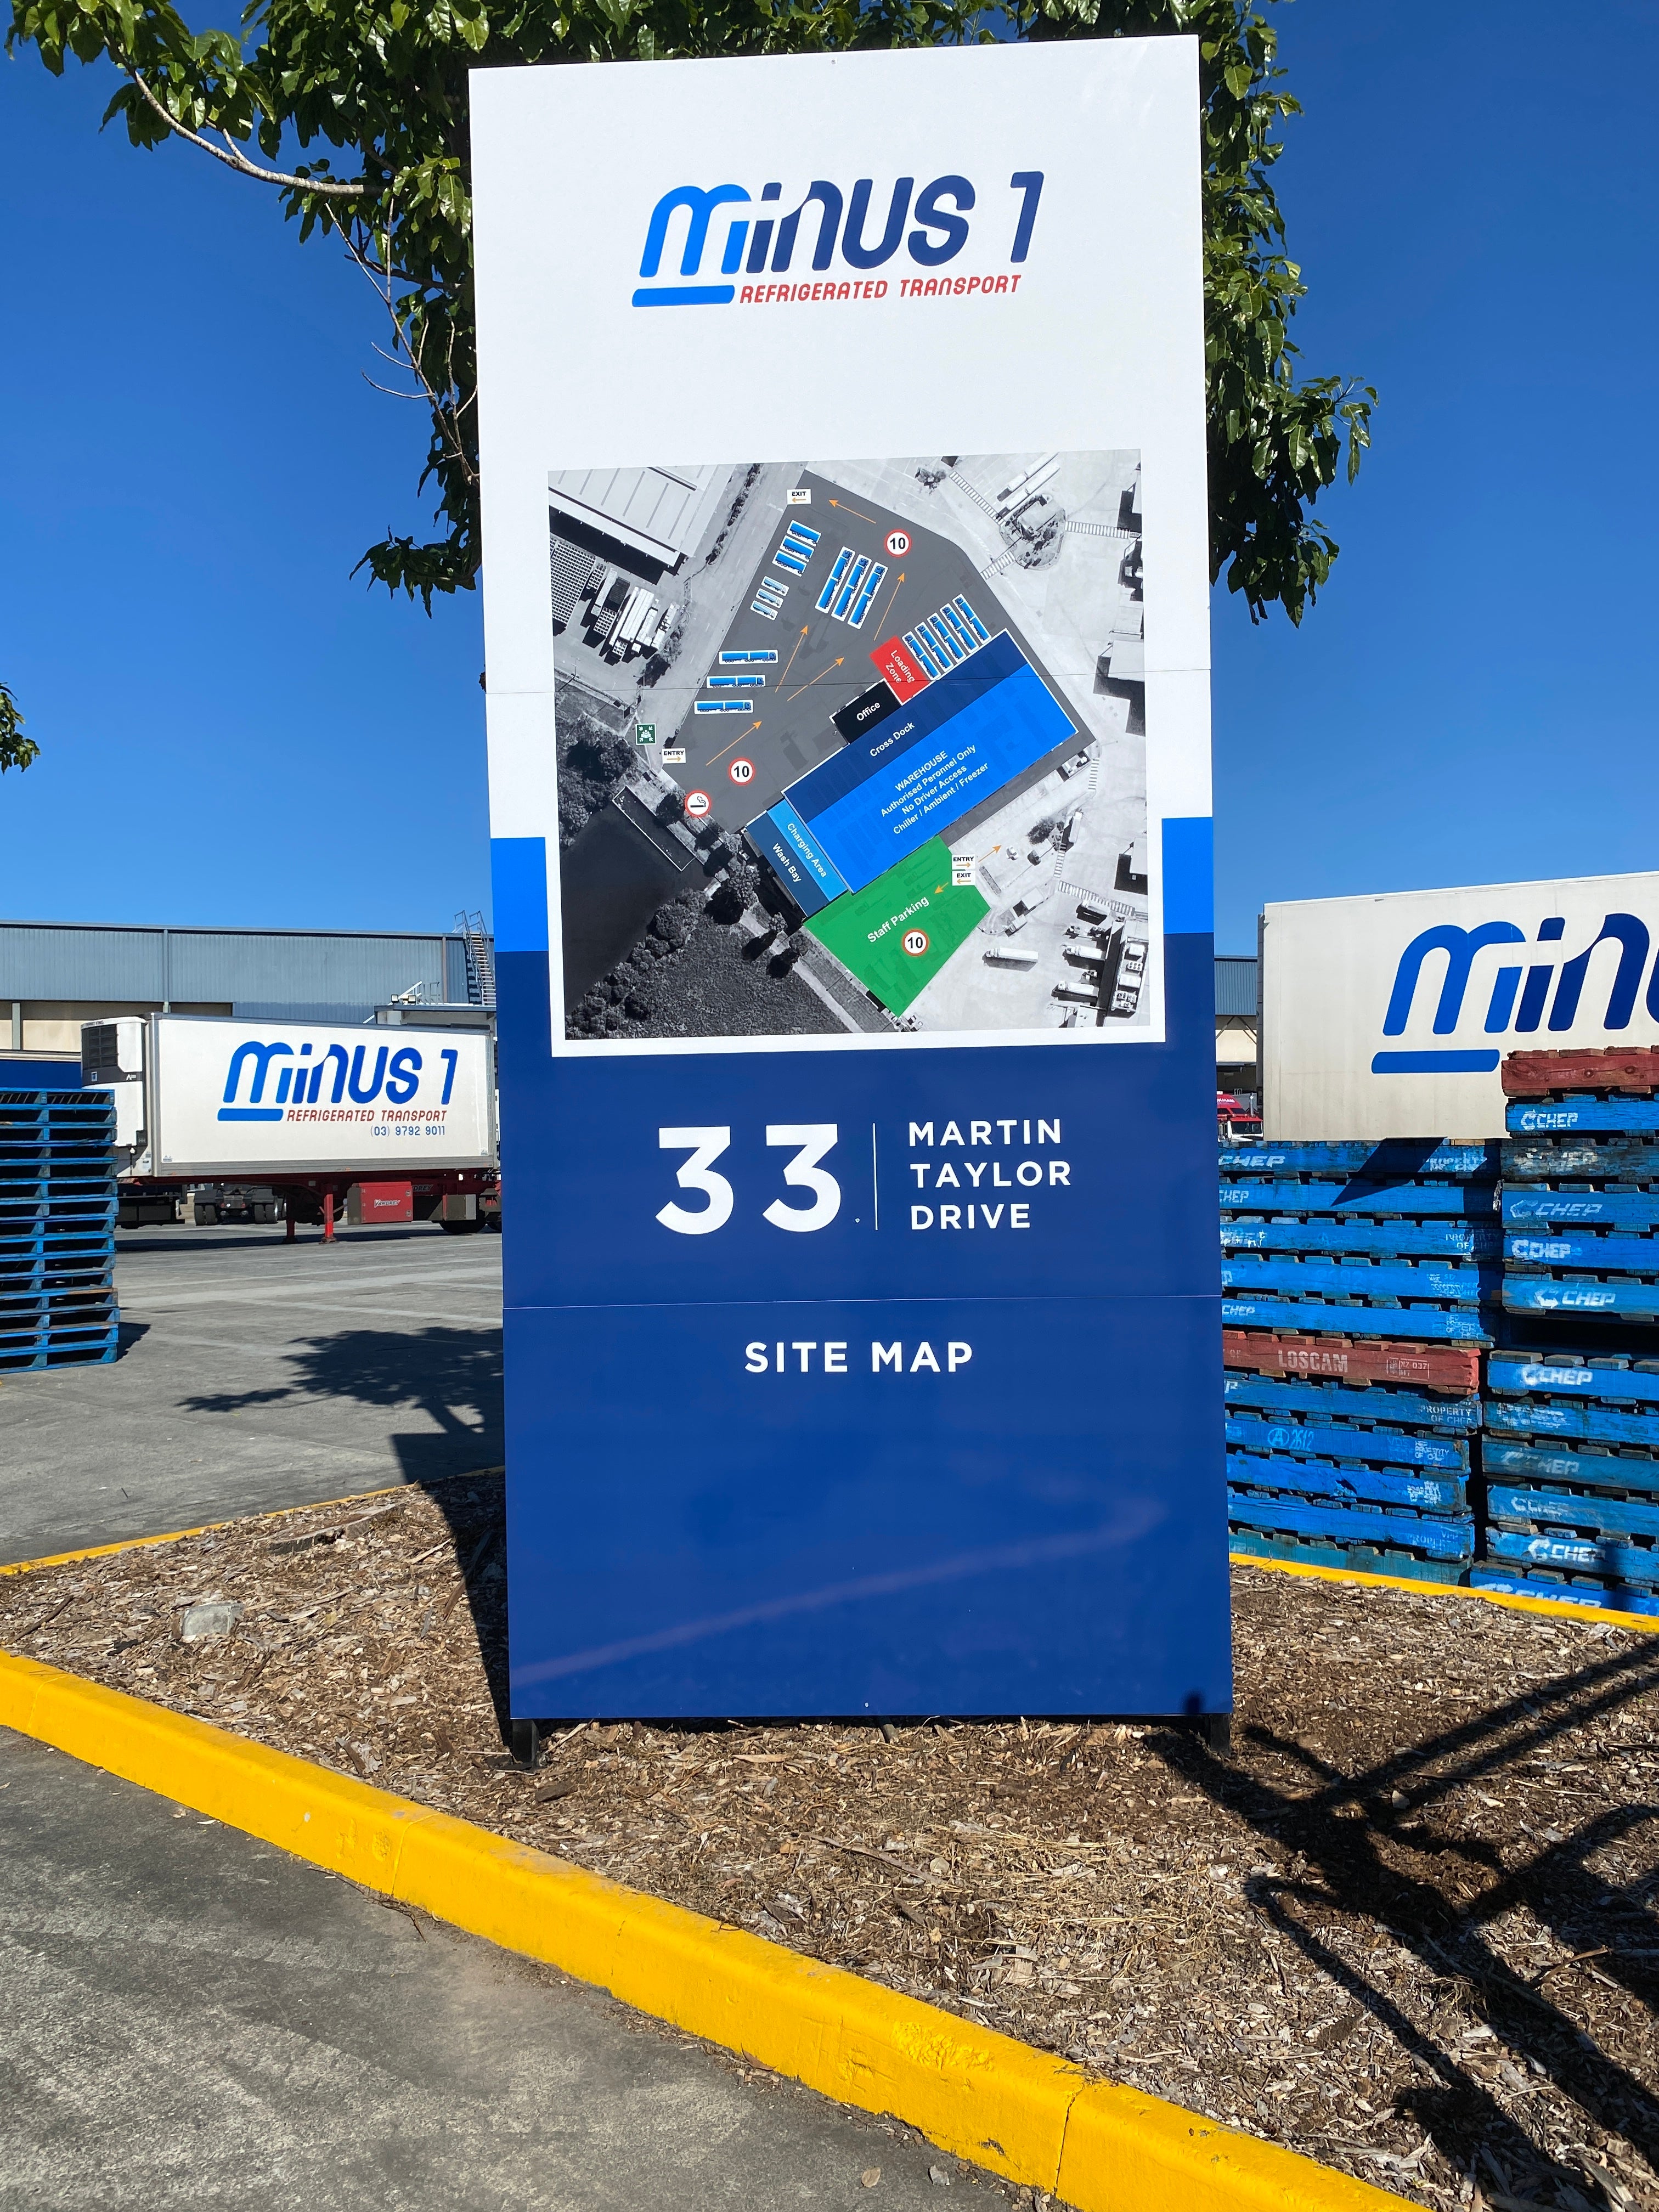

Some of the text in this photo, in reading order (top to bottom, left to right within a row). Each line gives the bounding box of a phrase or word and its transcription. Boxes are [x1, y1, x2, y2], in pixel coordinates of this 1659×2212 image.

[1010, 171, 1045, 263] 1
[740, 275, 1021, 303] REFRIGERATED TRANSPORT
[889, 537, 906, 550] 10
[885, 662, 902, 684] Zone
[890, 650, 916, 683] Loading
[856, 702, 881, 721] Office
[870, 722, 915, 757] Cross Dock
[733, 765, 749, 778] 10
[881, 744, 976, 817] Authorised Peronnel Only
[895, 751, 948, 791] WAREHOUSE
[893, 813, 919, 834] Chiller
[923, 786, 956, 814] Ambient
[958, 763, 989, 787] Freezer
[901, 765, 967, 815] No Driver Access
[787, 823, 827, 878] Charging Area
[772, 843, 802, 882] Wash Bay
[867, 895, 929, 943] Staff Parking
[907, 936, 923, 950] 10
[441, 1049, 458, 1105] 1
[287, 1109, 447, 1122] REFRIGERATED TRANSPORT
[1537, 1113, 1578, 1128] CHEP
[370, 1125, 445, 1137] (03) 9792 9011
[909, 1119, 1061, 1146] MARTIN
[1218, 1155, 1285, 1168] CHEP
[910, 1161, 1071, 1188] TAYLOR
[374, 1199, 400, 1208] VAWDREY
[1536, 1203, 1603, 1216] CHEP
[911, 1203, 1031, 1230] DRIVE
[1562, 1290, 1616, 1306] CHEP
[1221, 1304, 1255, 1316] CHEP
[745, 1341, 973, 1373] SITE MAP
[1278, 1350, 1348, 1373] LOSCAM
[1539, 1370, 1593, 1385] CHEP
[1420, 1405, 1471, 1417] PROPERTY
[1431, 1414, 1443, 1423] OF
